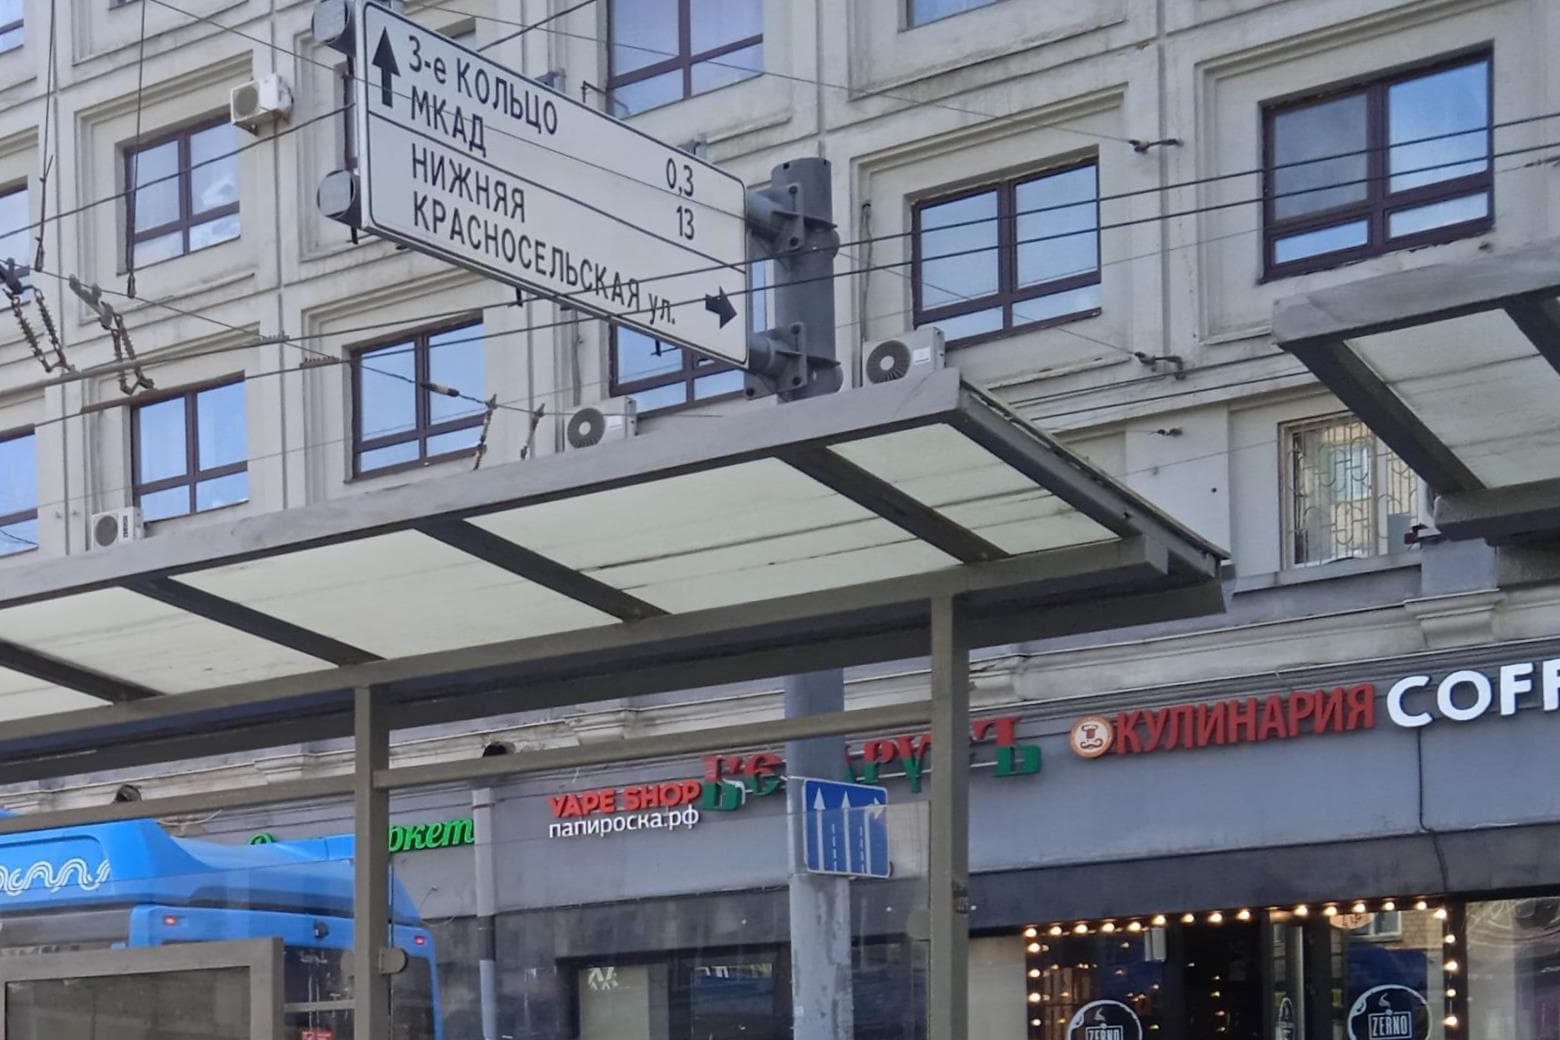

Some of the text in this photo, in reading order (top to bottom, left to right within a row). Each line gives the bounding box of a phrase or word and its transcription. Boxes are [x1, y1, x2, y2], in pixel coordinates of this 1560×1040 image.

[410, 86, 487, 158] МКАД
[456, 56, 559, 136] КОЛЬЦО
[411, 142, 526, 224] НИЖНЯЯ
[665, 157, 696, 198] 0,3
[675, 205, 697, 241] 13
[413, 190, 678, 328] КРАСНОСЕЛЬСКАЯ ул.
[1115, 682, 1376, 756] КУЛИНАРИЯ
[548, 778, 702, 819] VAPE SHOP
[548, 803, 701, 841] папироска.рф
[1373, 1013, 1408, 1037] ZERNO
